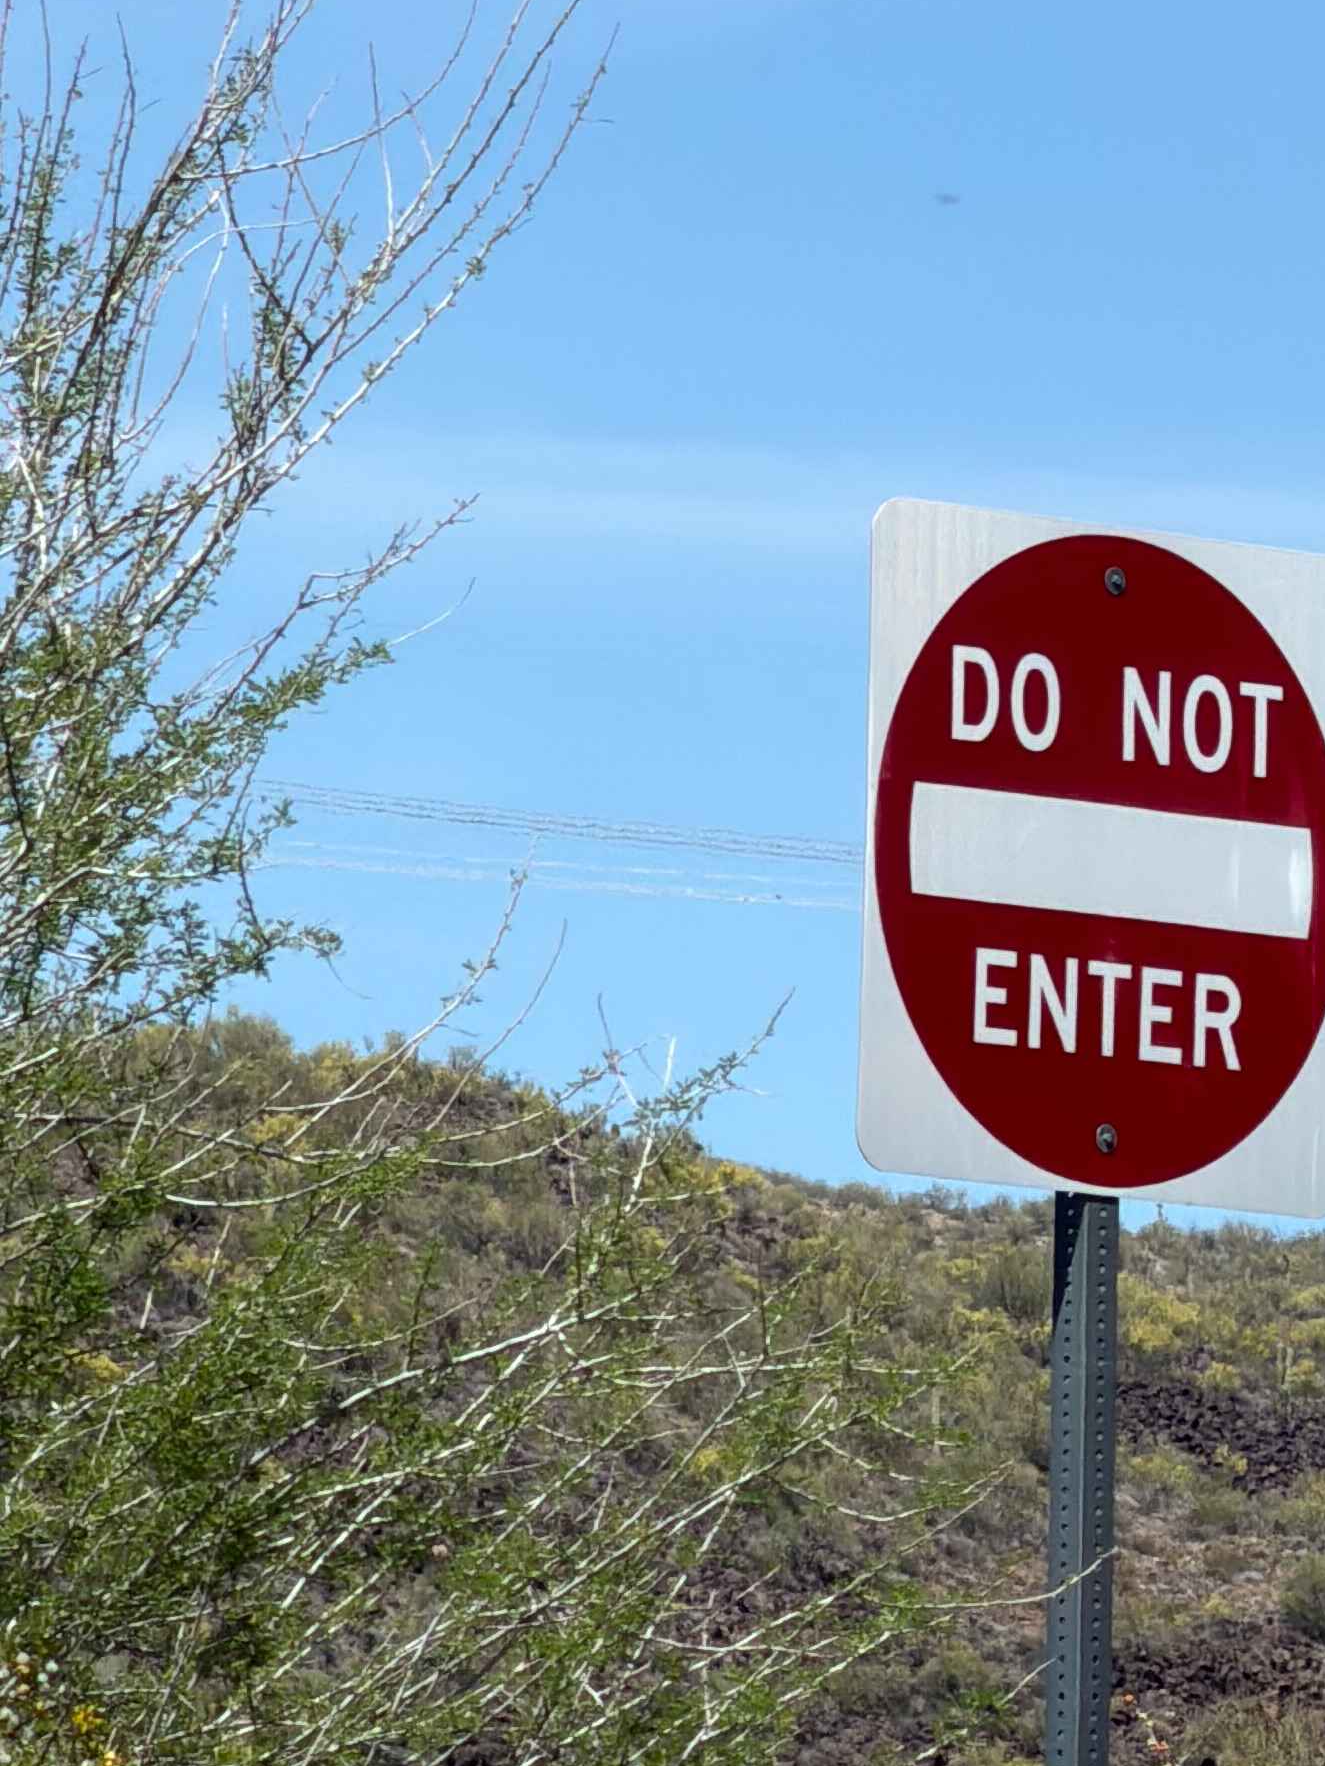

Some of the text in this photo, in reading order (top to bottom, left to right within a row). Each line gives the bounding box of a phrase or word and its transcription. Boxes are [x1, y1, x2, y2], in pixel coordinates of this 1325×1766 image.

[950, 644, 1284, 778] DO NOT
[972, 947, 1243, 1071] ENTER
